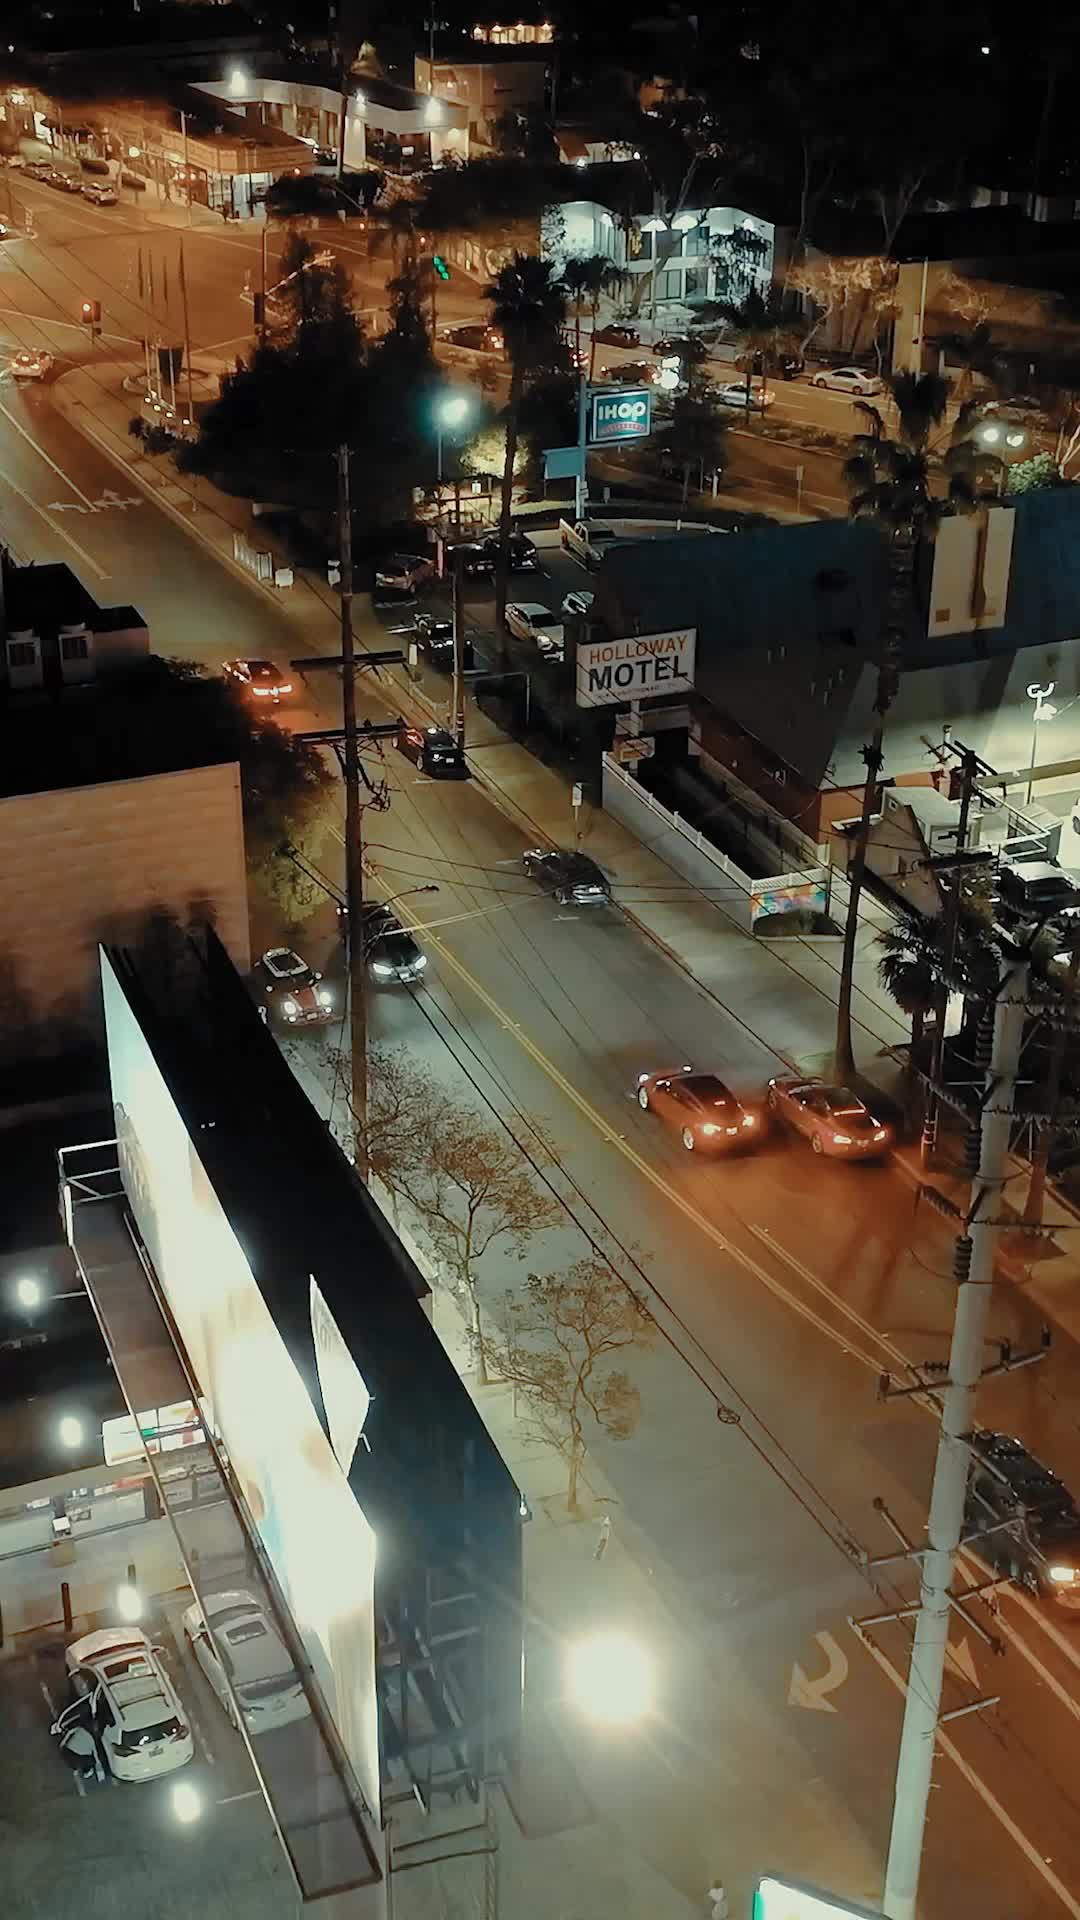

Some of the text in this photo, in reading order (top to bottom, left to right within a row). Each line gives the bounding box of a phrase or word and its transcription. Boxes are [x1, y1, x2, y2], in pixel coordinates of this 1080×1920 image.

[598, 401, 646, 421] IHOP
[590, 635, 687, 664] HOLLOWAY
[589, 656, 688, 692] MOTEL
